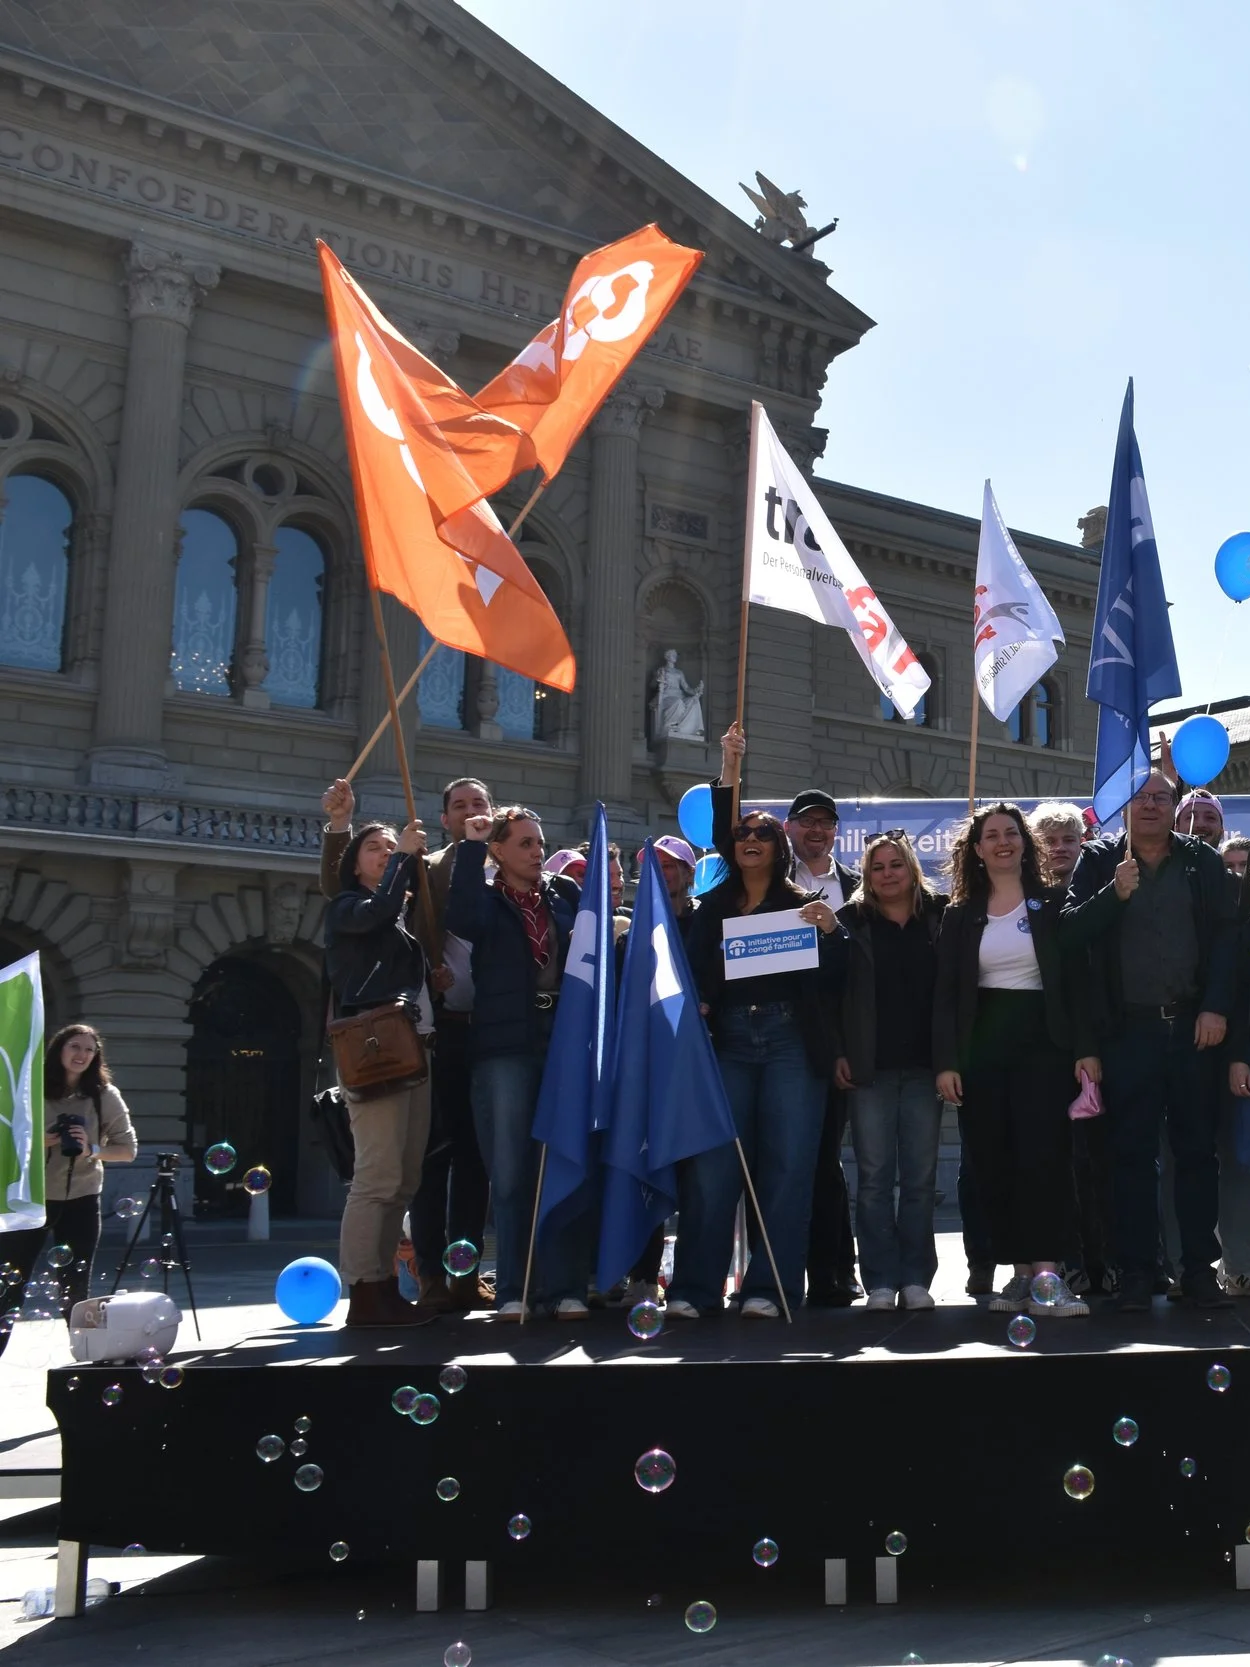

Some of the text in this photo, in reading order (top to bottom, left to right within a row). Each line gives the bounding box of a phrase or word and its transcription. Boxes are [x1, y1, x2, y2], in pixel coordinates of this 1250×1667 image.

[0, 126, 454, 289] CONFOEDERATIONIS
[763, 552, 778, 567] Der
[748, 937, 781, 946] Initiative
[783, 933, 801, 942] pour
[748, 940, 802, 953] congé familial
